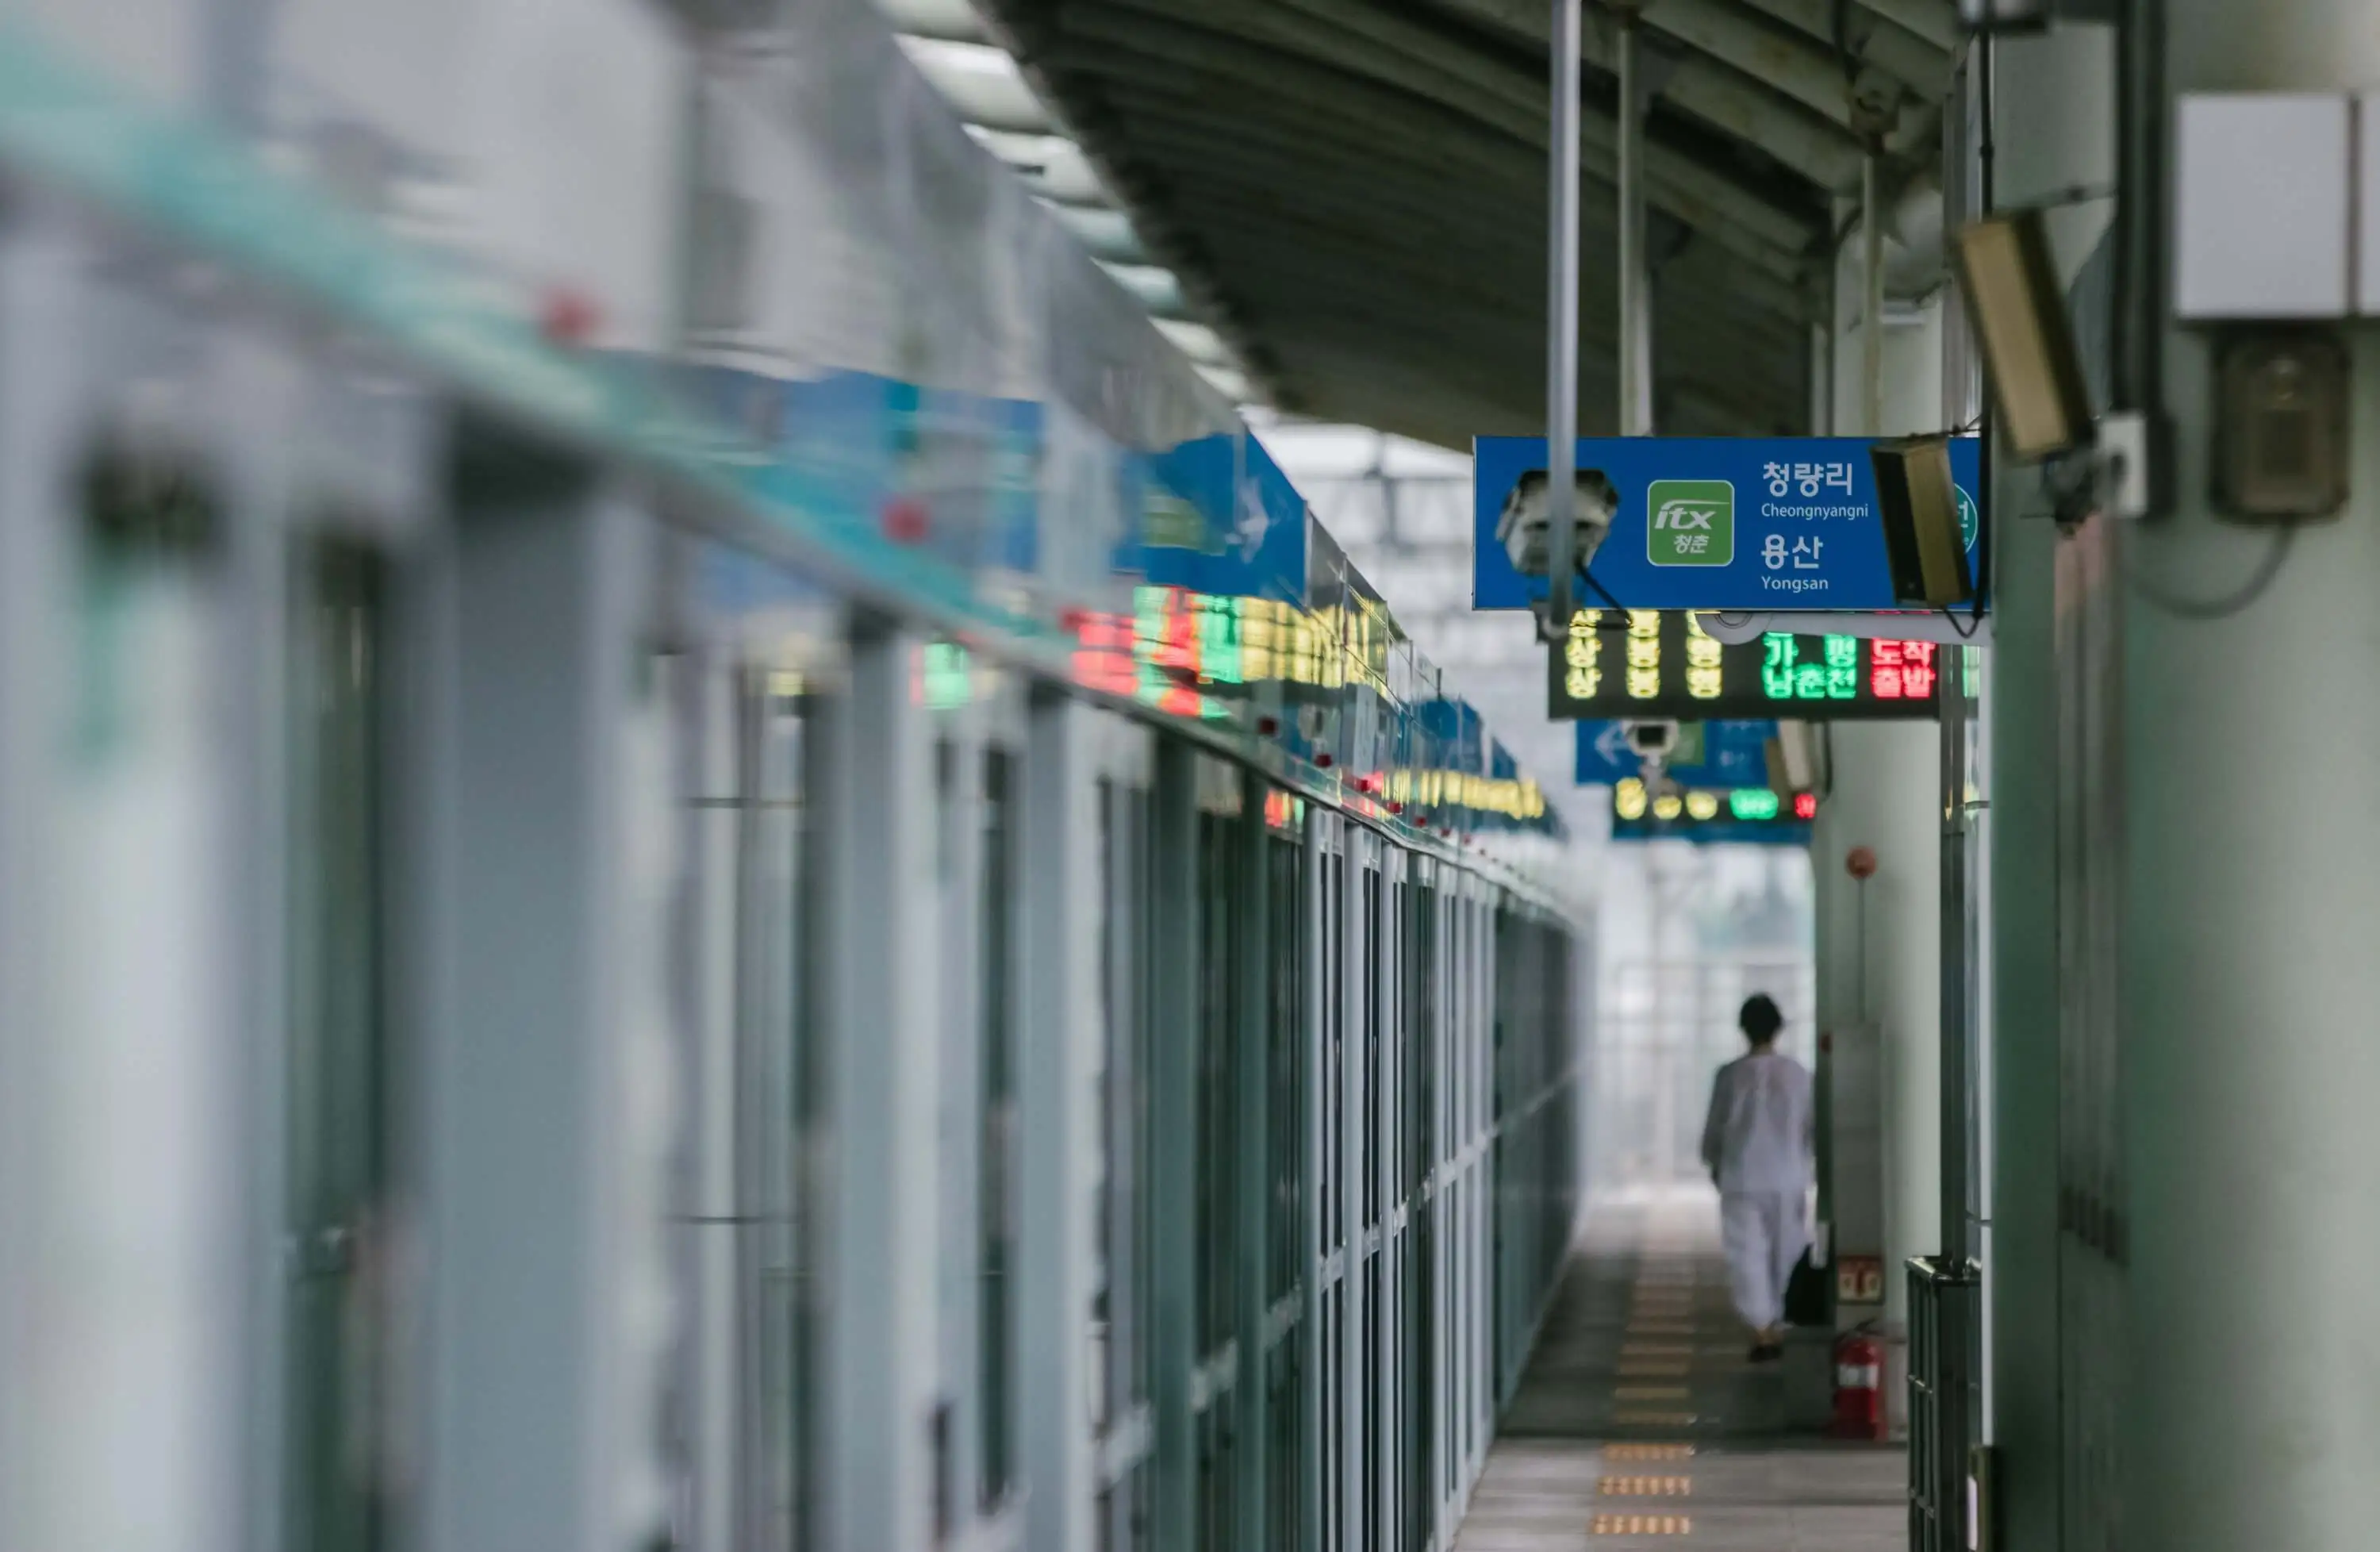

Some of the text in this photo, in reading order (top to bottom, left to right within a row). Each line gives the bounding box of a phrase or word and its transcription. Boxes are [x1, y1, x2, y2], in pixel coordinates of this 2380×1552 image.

[1763, 462, 1852, 497] 청량리
[1761, 503, 1868, 521] Cheongnyangni
[1674, 534, 1710, 554] 청춘
[1760, 534, 1824, 570] 용산
[1761, 576, 1829, 594] Yongsan
[1871, 667, 1936, 698] 출발
